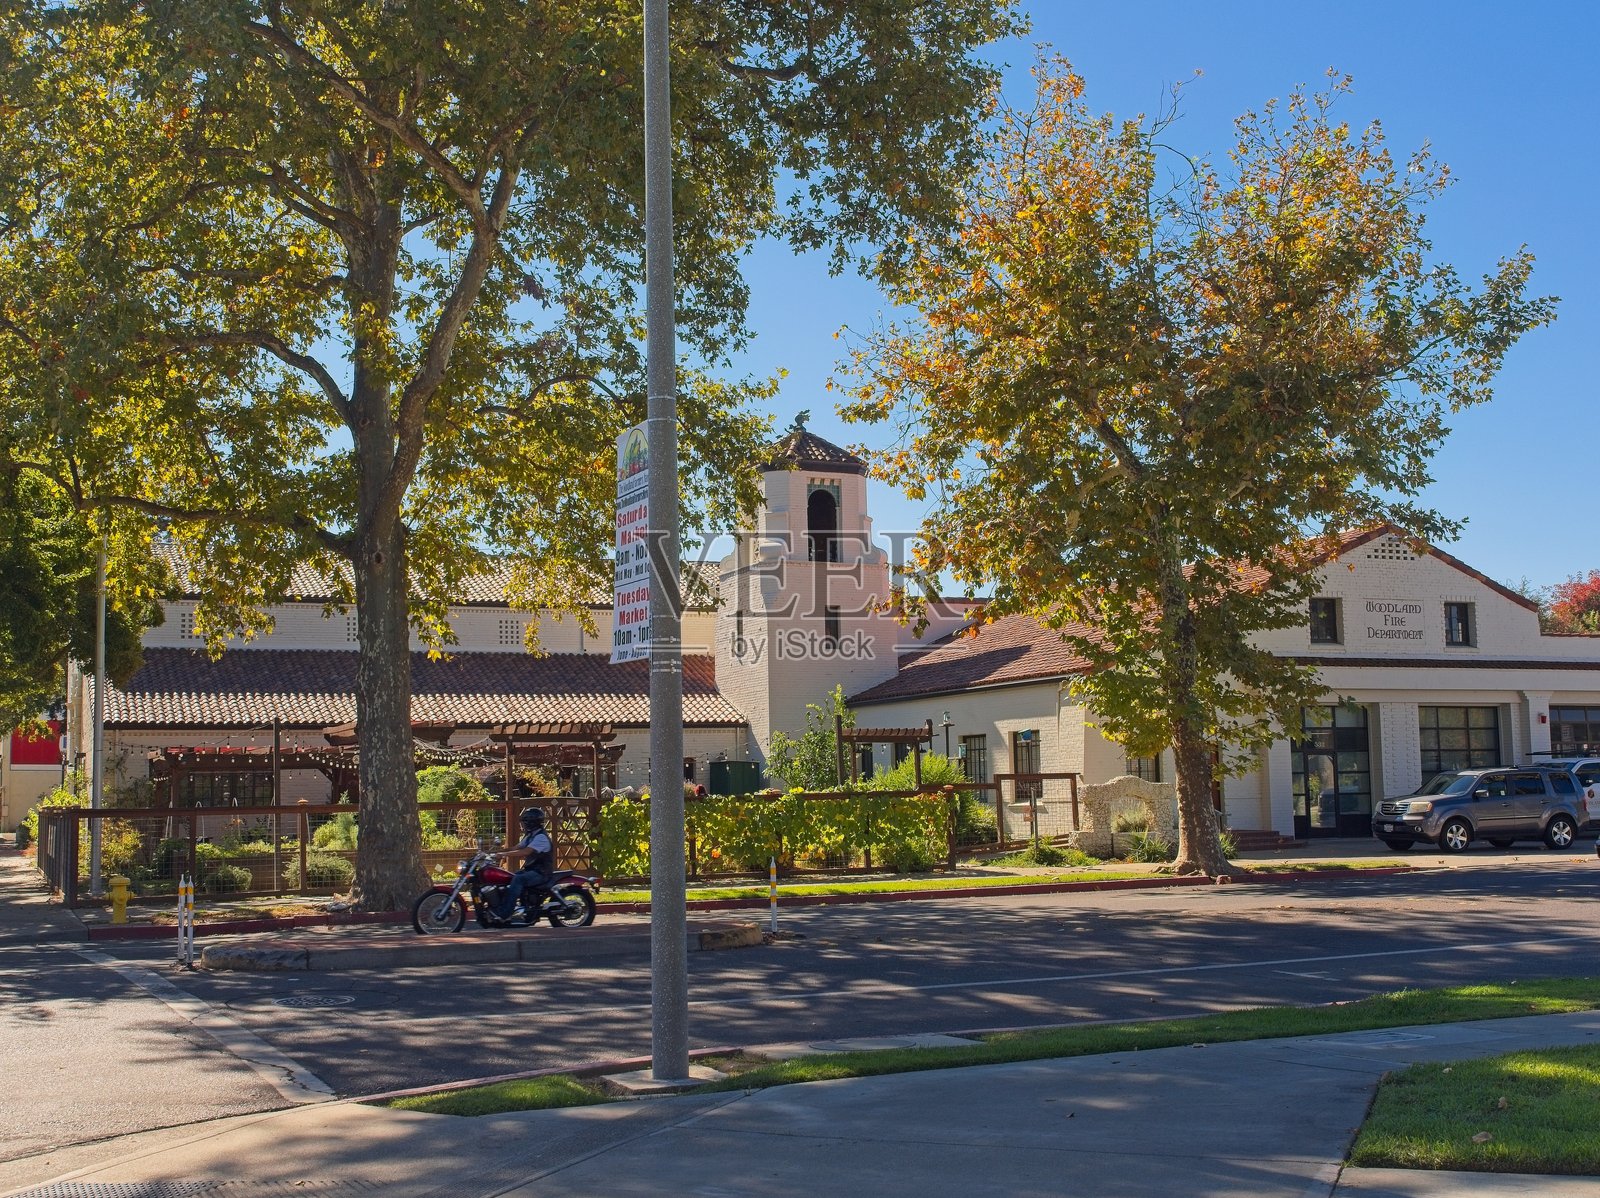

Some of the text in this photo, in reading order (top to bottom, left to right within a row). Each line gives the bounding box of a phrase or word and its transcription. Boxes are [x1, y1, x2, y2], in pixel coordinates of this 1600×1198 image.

[618, 505, 648, 528] Saturda
[621, 524, 648, 546] Market
[616, 550, 630, 567] 9am
[617, 587, 650, 607] Tuesday
[618, 606, 648, 626] Market
[1365, 601, 1422, 614] WOODLAND
[1383, 614, 1407, 626] FIRE
[613, 629, 632, 646] 10am
[1367, 626, 1424, 640] DEPARTMENT
